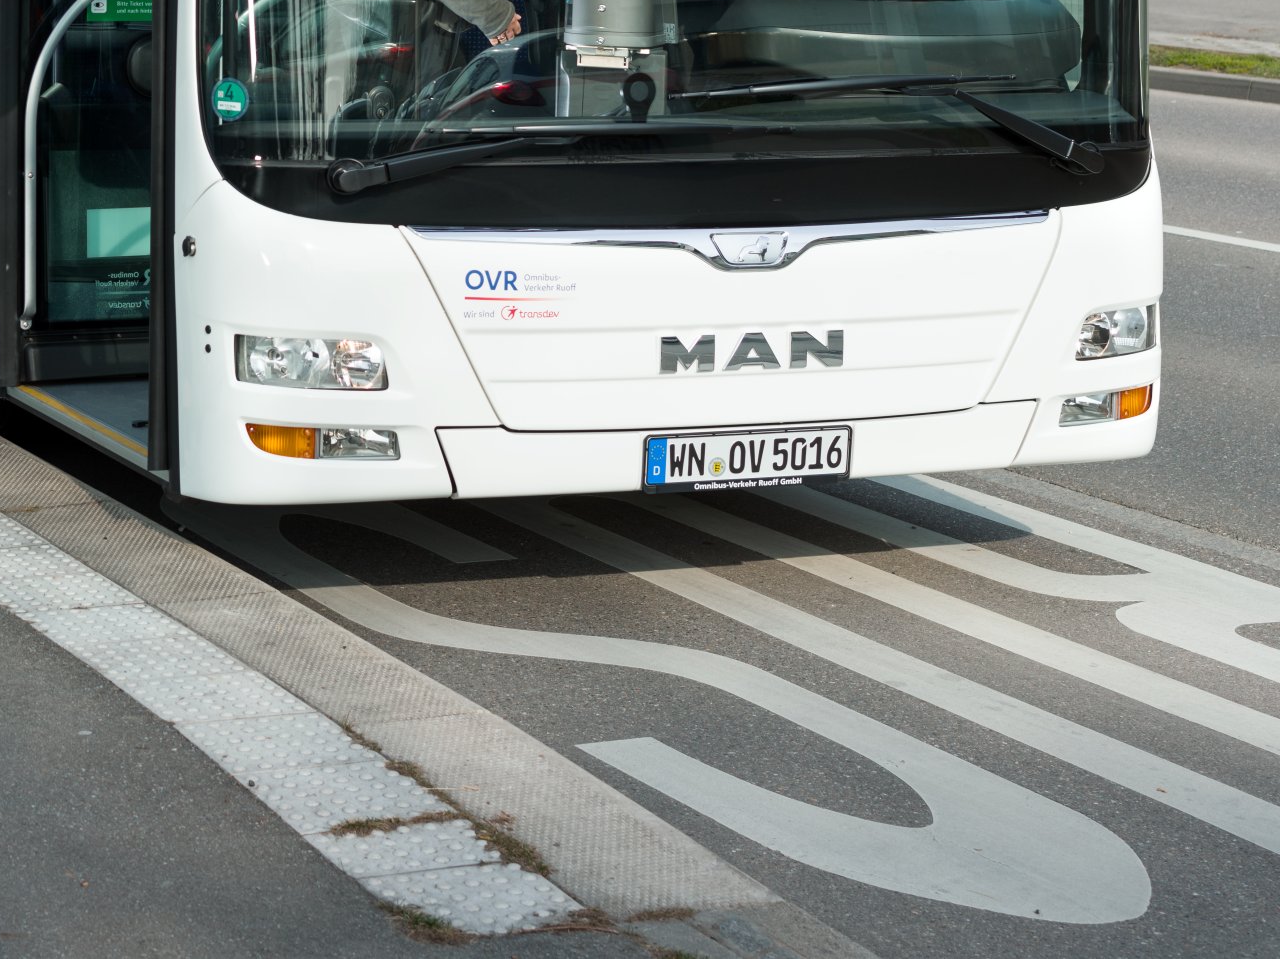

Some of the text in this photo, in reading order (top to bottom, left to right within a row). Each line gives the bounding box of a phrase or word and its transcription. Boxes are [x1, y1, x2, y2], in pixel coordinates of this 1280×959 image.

[224, 83, 235, 101] 4
[465, 269, 518, 291] OVR
[524, 273, 561, 282] Omnibus-
[524, 282, 577, 292] Verkehr Ruoff
[463, 309, 560, 319] Wir sind transdev
[658, 329, 844, 375] MAN
[653, 435, 842, 478] D WN OV 5016
[693, 477, 802, 490] Omnibus-Verkehr Ruoff GmbH
